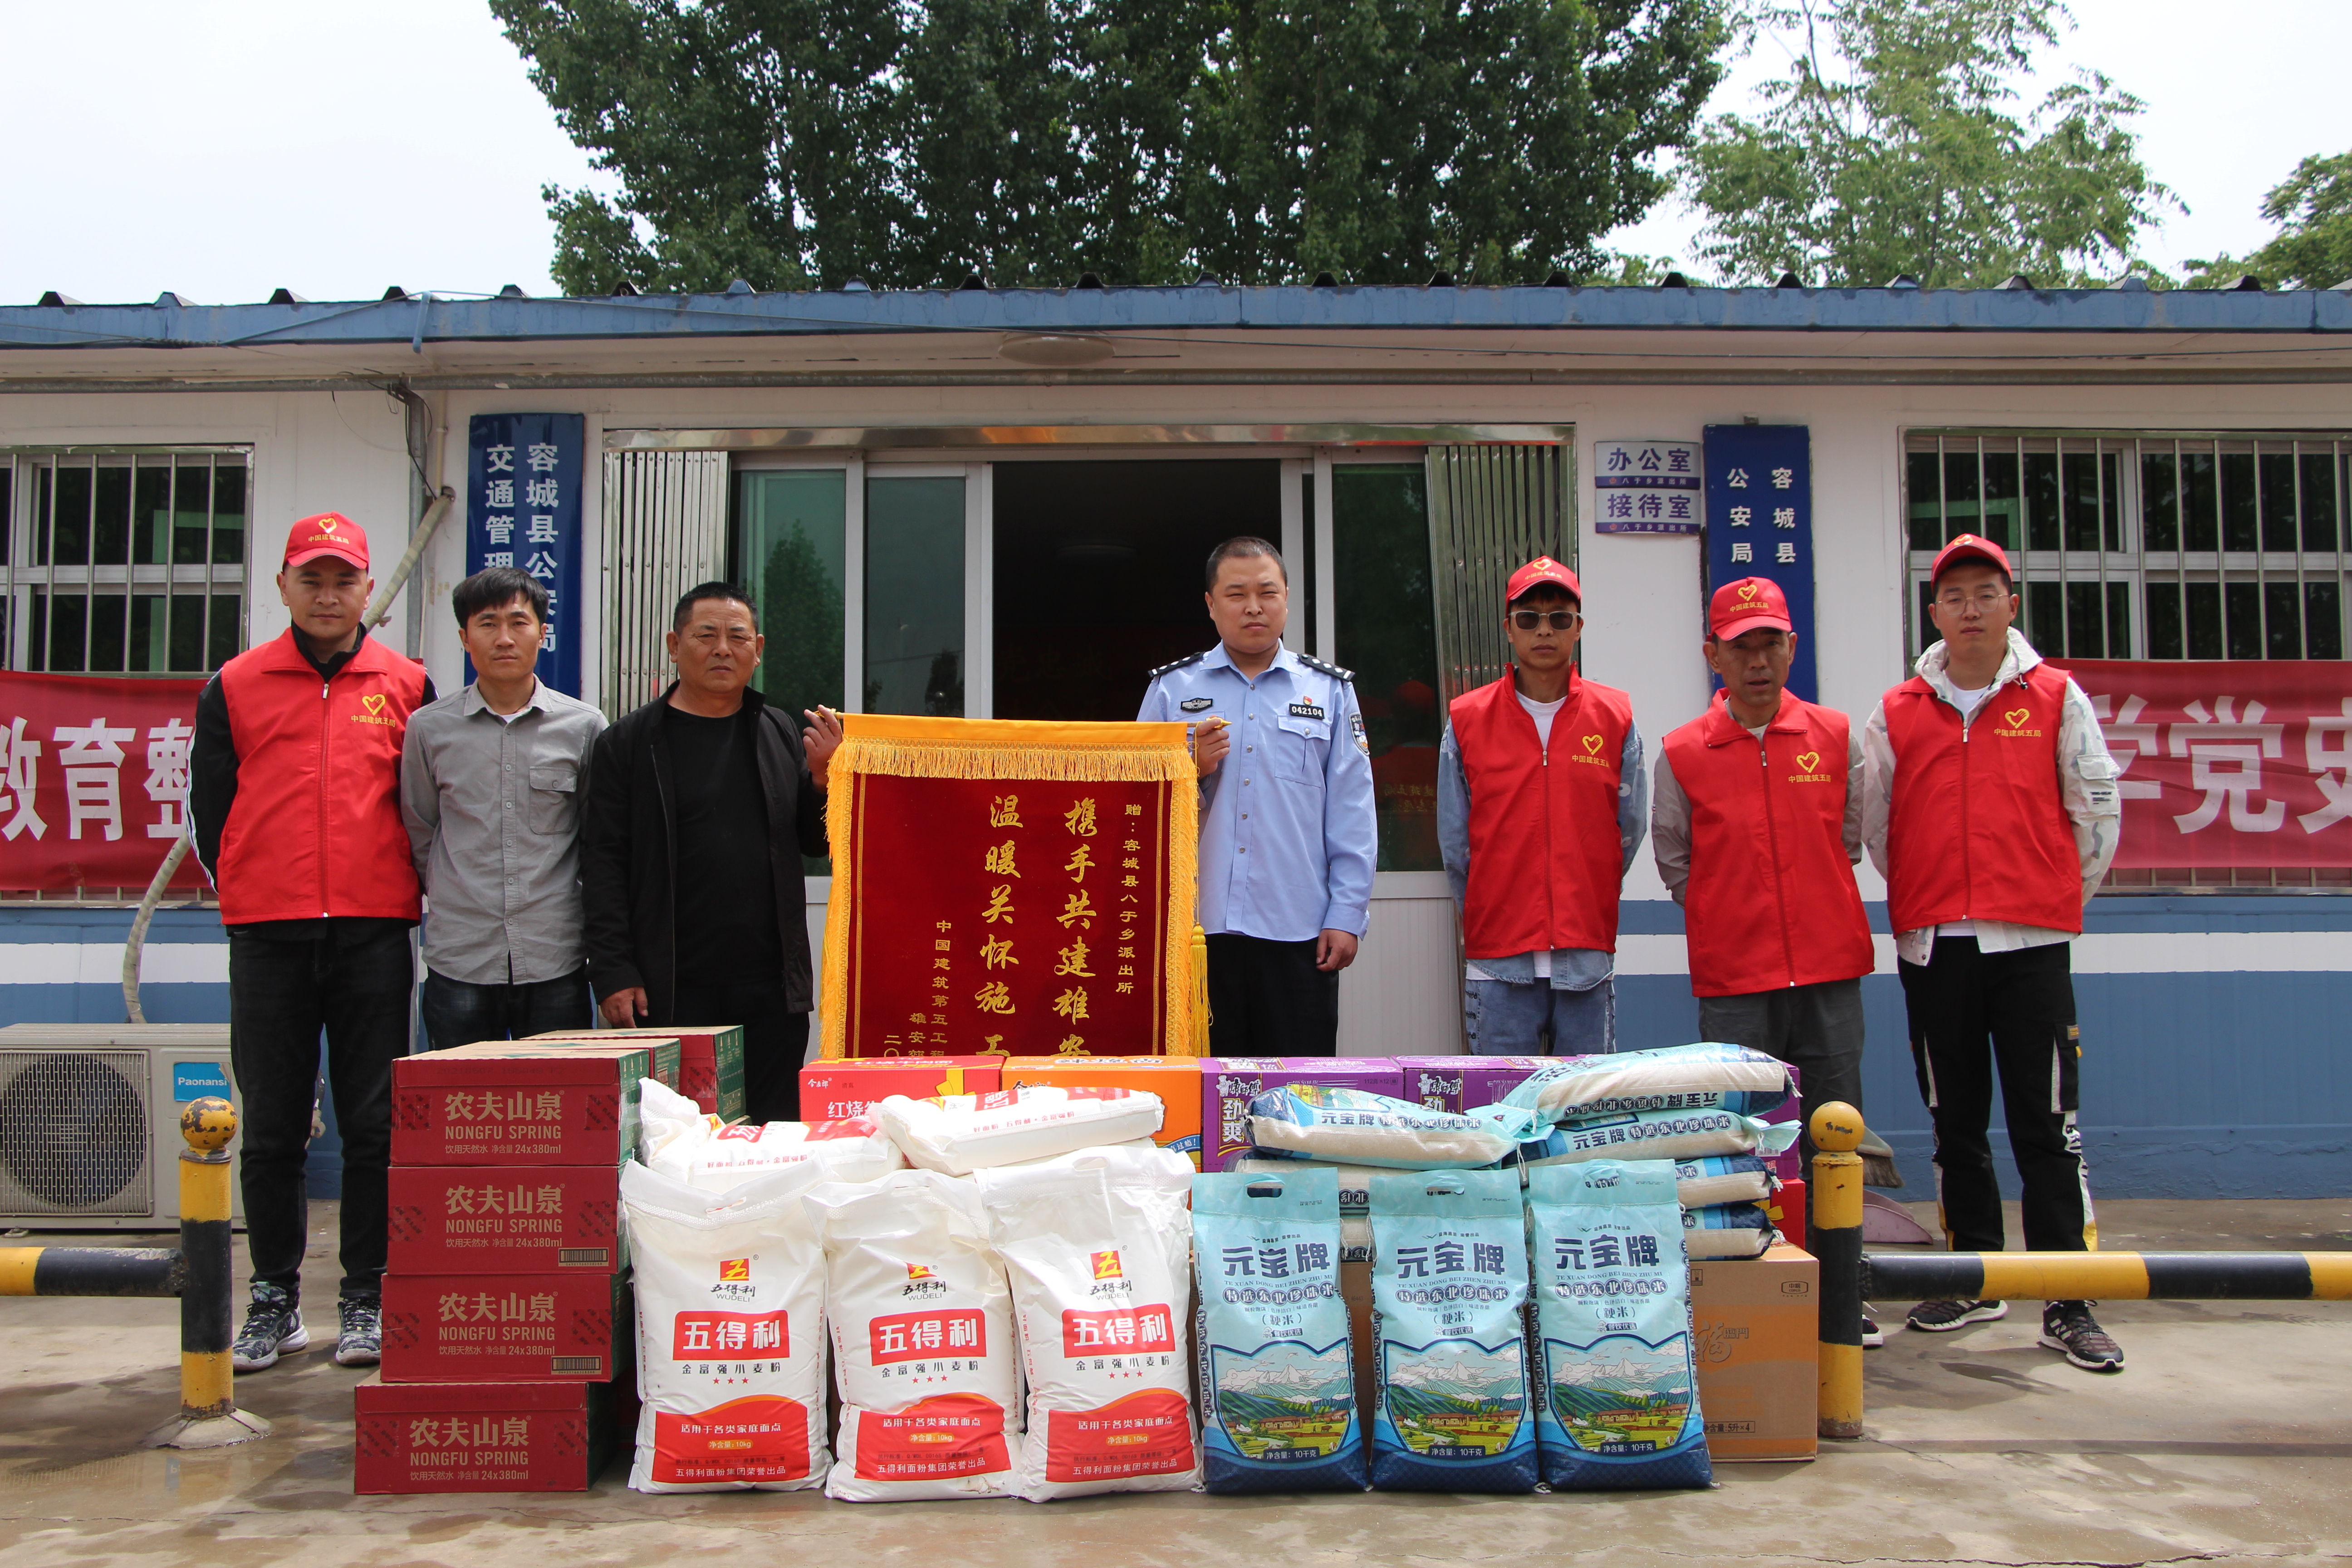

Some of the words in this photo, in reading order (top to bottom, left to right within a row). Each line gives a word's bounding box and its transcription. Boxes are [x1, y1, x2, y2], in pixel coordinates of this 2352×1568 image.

[1608, 447, 1691, 473] 办公室
[1607, 493, 1691, 519] 接待室
[1727, 468, 1753, 564] 公安局
[1772, 467, 1796, 564] 容城县
[309, 534, 349, 544] 中国建筑五局
[1730, 602, 1769, 612] 中国建筑五局
[1291, 706, 1323, 718] 042104
[1994, 728, 2041, 737] 中国建筑五局
[1788, 774, 1831, 783] 中国建筑五局
[178, 1077, 227, 1086] Paonansi
[808, 1078, 828, 1089] 今麦郎
[445, 1091, 562, 1121] 农夫山泉
[1223, 1098, 1244, 1143] 劲爽
[1321, 1112, 1375, 1126] 元宝牌
[446, 1126, 502, 1140] NONGFU
[509, 1126, 561, 1139] SPRING
[973, 1125, 999, 1133] 好面粉
[1572, 1128, 1626, 1150] 元宝牌
[1628, 1114, 1731, 1140] 特选东北珍珠米
[446, 1145, 488, 1154] 饮用天然水
[491, 1145, 513, 1154] 净含量
[515, 1145, 561, 1154] 24x380ml
[446, 1184, 563, 1214] 农夫山泉
[446, 1220, 503, 1233] NONGFU
[510, 1219, 562, 1232] SPRING
[446, 1239, 489, 1248] 饮用天然水
[492, 1238, 514, 1247] 净含量
[516, 1238, 562, 1247] 24x380ml
[1555, 1234, 1659, 1269] 元宝牌
[1222, 1243, 1330, 1279] 元宝牌
[1397, 1241, 1504, 1279] 元宝牌
[710, 1284, 756, 1297] 五得利
[902, 1281, 946, 1296] 五得利
[1090, 1280, 1132, 1295] 五得利
[1223, 1281, 1336, 1305] 特选东北珍珠米
[1396, 1284, 1509, 1304] 特选东北珍珠米
[1555, 1279, 1667, 1298] 特选东北珍珠米
[716, 1294, 750, 1302] WUDELI
[908, 1293, 942, 1301] WUDELI
[438, 1292, 556, 1322] 农夫山泉
[439, 1327, 496, 1340] NONGFU
[503, 1327, 555, 1340] SPRING
[683, 1319, 781, 1350] 五得利
[879, 1318, 977, 1354] 五得利
[1073, 1313, 1167, 1347] 五得利
[439, 1346, 481, 1355] 饮用天然水
[485, 1346, 506, 1355] 净含量
[509, 1346, 555, 1355] 24x380ml
[682, 1362, 780, 1374] 金富强小麦粉
[882, 1361, 978, 1378] 金富强小麦粉
[1076, 1355, 1170, 1371] 金富强小麦粉
[681, 1423, 781, 1434] 适用于各类家庭面点
[883, 1417, 980, 1428] 适用于各类家庭面点
[1078, 1416, 1173, 1430] 适用于各类家庭面点
[409, 1417, 529, 1447] 农夫山泉
[411, 1452, 468, 1465] NONGFU
[475, 1451, 528, 1465] SPRING
[676, 1466, 786, 1477] 五得利面粉集团荣誉出品
[877, 1457, 985, 1474] 五得利面粉集团荣誉出品
[1073, 1458, 1177, 1475] 五得利面粉集团荣誉出品
[410, 1471, 454, 1481] 饮用天然水
[457, 1471, 479, 1480] 净含量
[482, 1470, 528, 1480] 24x380ml
